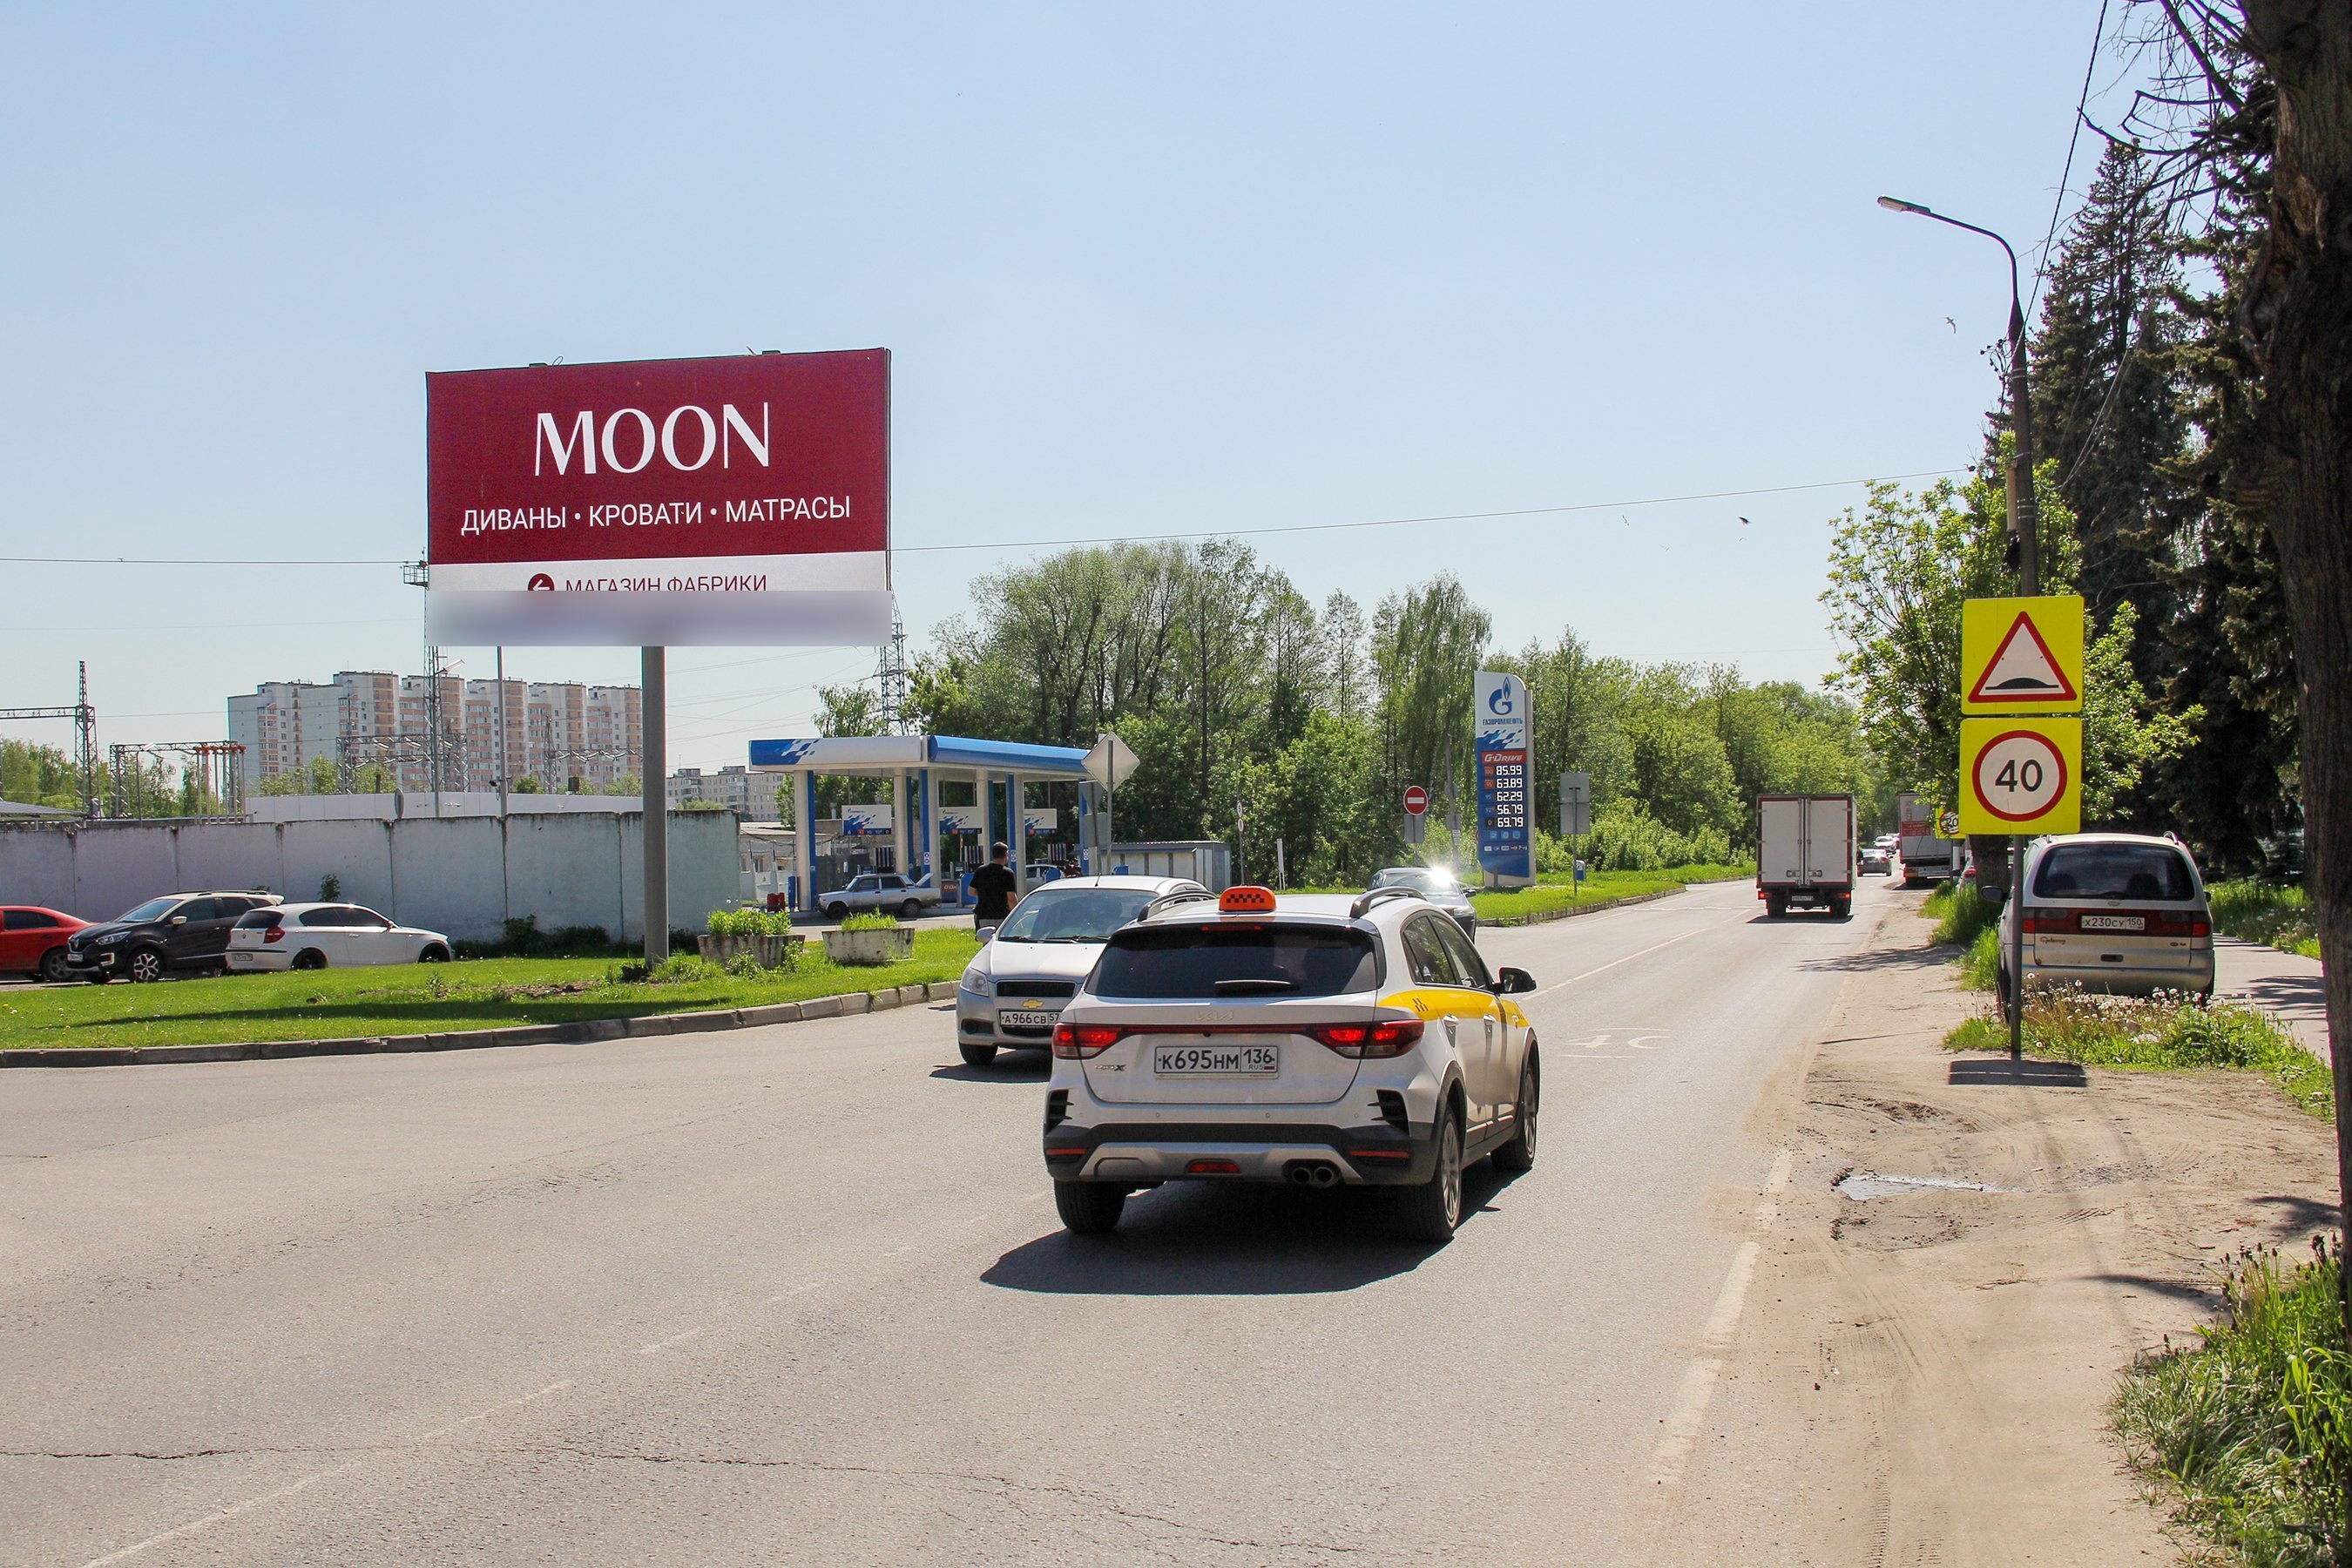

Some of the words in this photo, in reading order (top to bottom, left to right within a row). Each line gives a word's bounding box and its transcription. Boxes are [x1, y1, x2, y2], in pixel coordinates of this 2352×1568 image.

[534, 402, 769, 476] MOON
[461, 506, 566, 537] ДИВАНЫ
[589, 502, 701, 528] КРОВАТИ
[726, 496, 850, 523] МАТРАСЫ
[1496, 765, 1523, 775] 85.99
[1995, 759, 2043, 792] 40
[1497, 778, 1523, 788] 63.89
[1497, 791, 1523, 801] 62.29
[1497, 804, 1524, 814] 56.79
[1497, 817, 1524, 828] 69.79
[1243, 1048, 1273, 1064] 136
